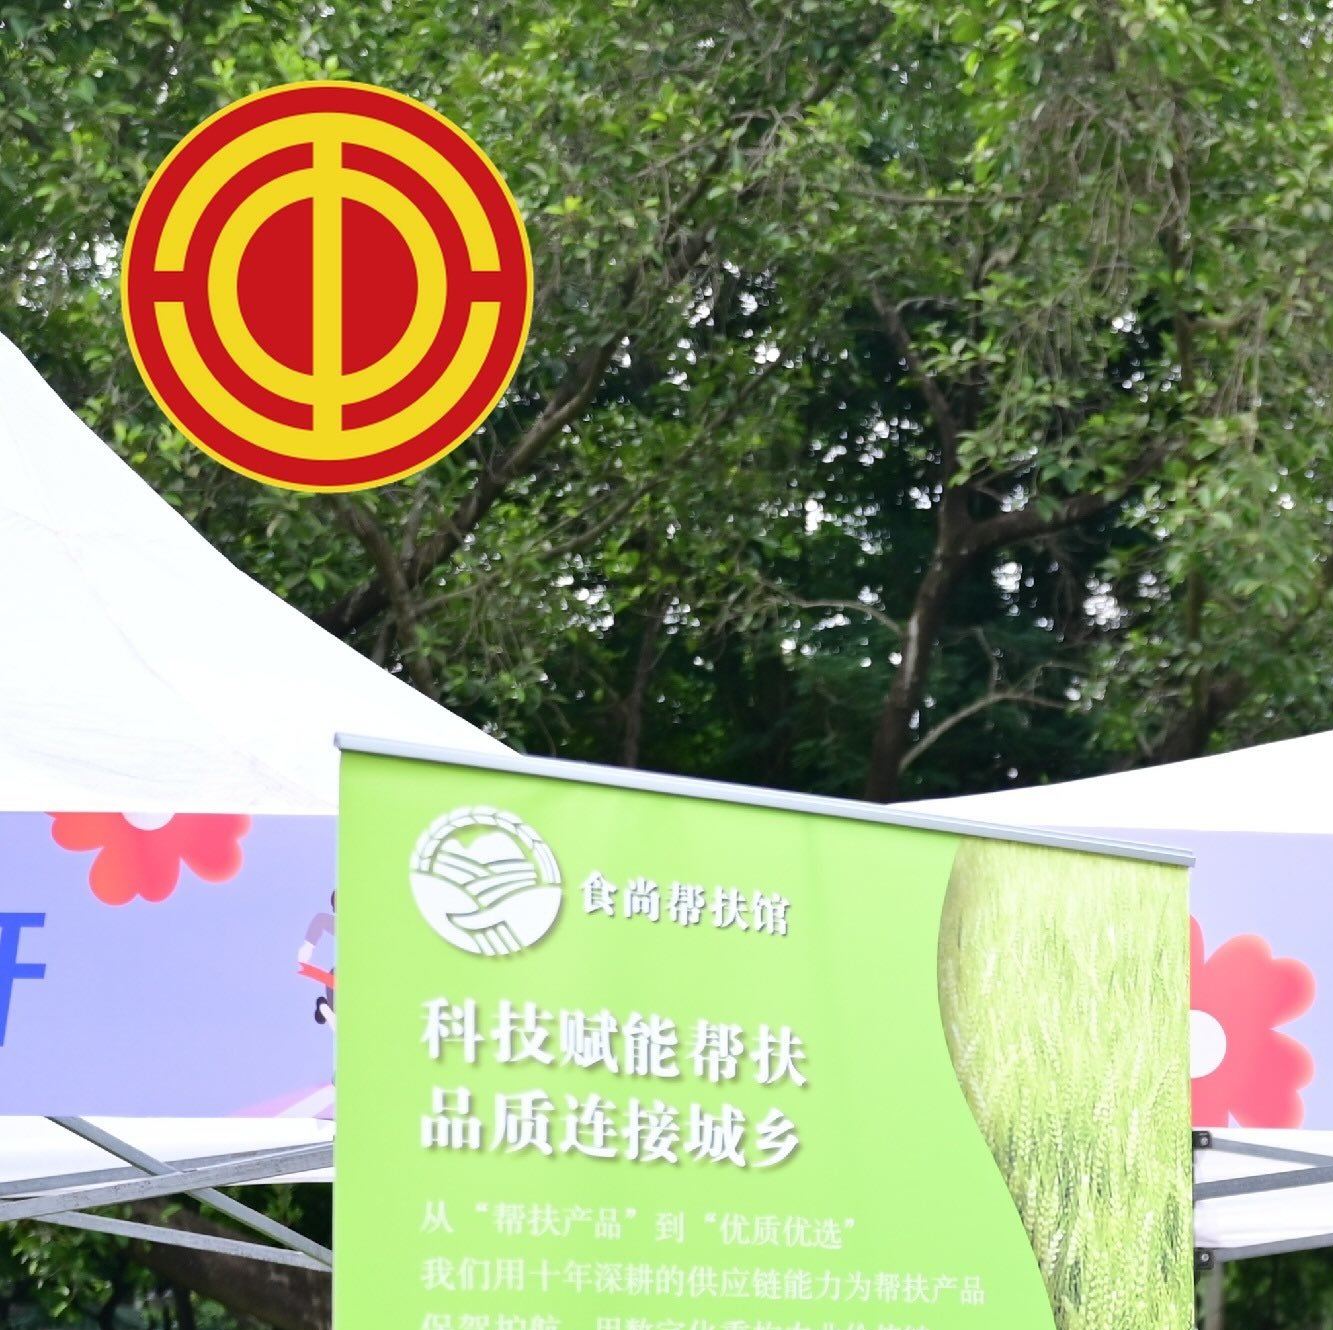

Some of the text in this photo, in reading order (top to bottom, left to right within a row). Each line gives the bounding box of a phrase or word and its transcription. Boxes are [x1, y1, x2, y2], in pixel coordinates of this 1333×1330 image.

[580, 869, 793, 937] 食尚帮扶馆
[421, 997, 808, 1088] 科技赋能帮扶
[421, 1087, 800, 1169] 品质连接城乡
[421, 1256, 986, 1306] 我们用十年深耕的供应链能力为帮扶产品
